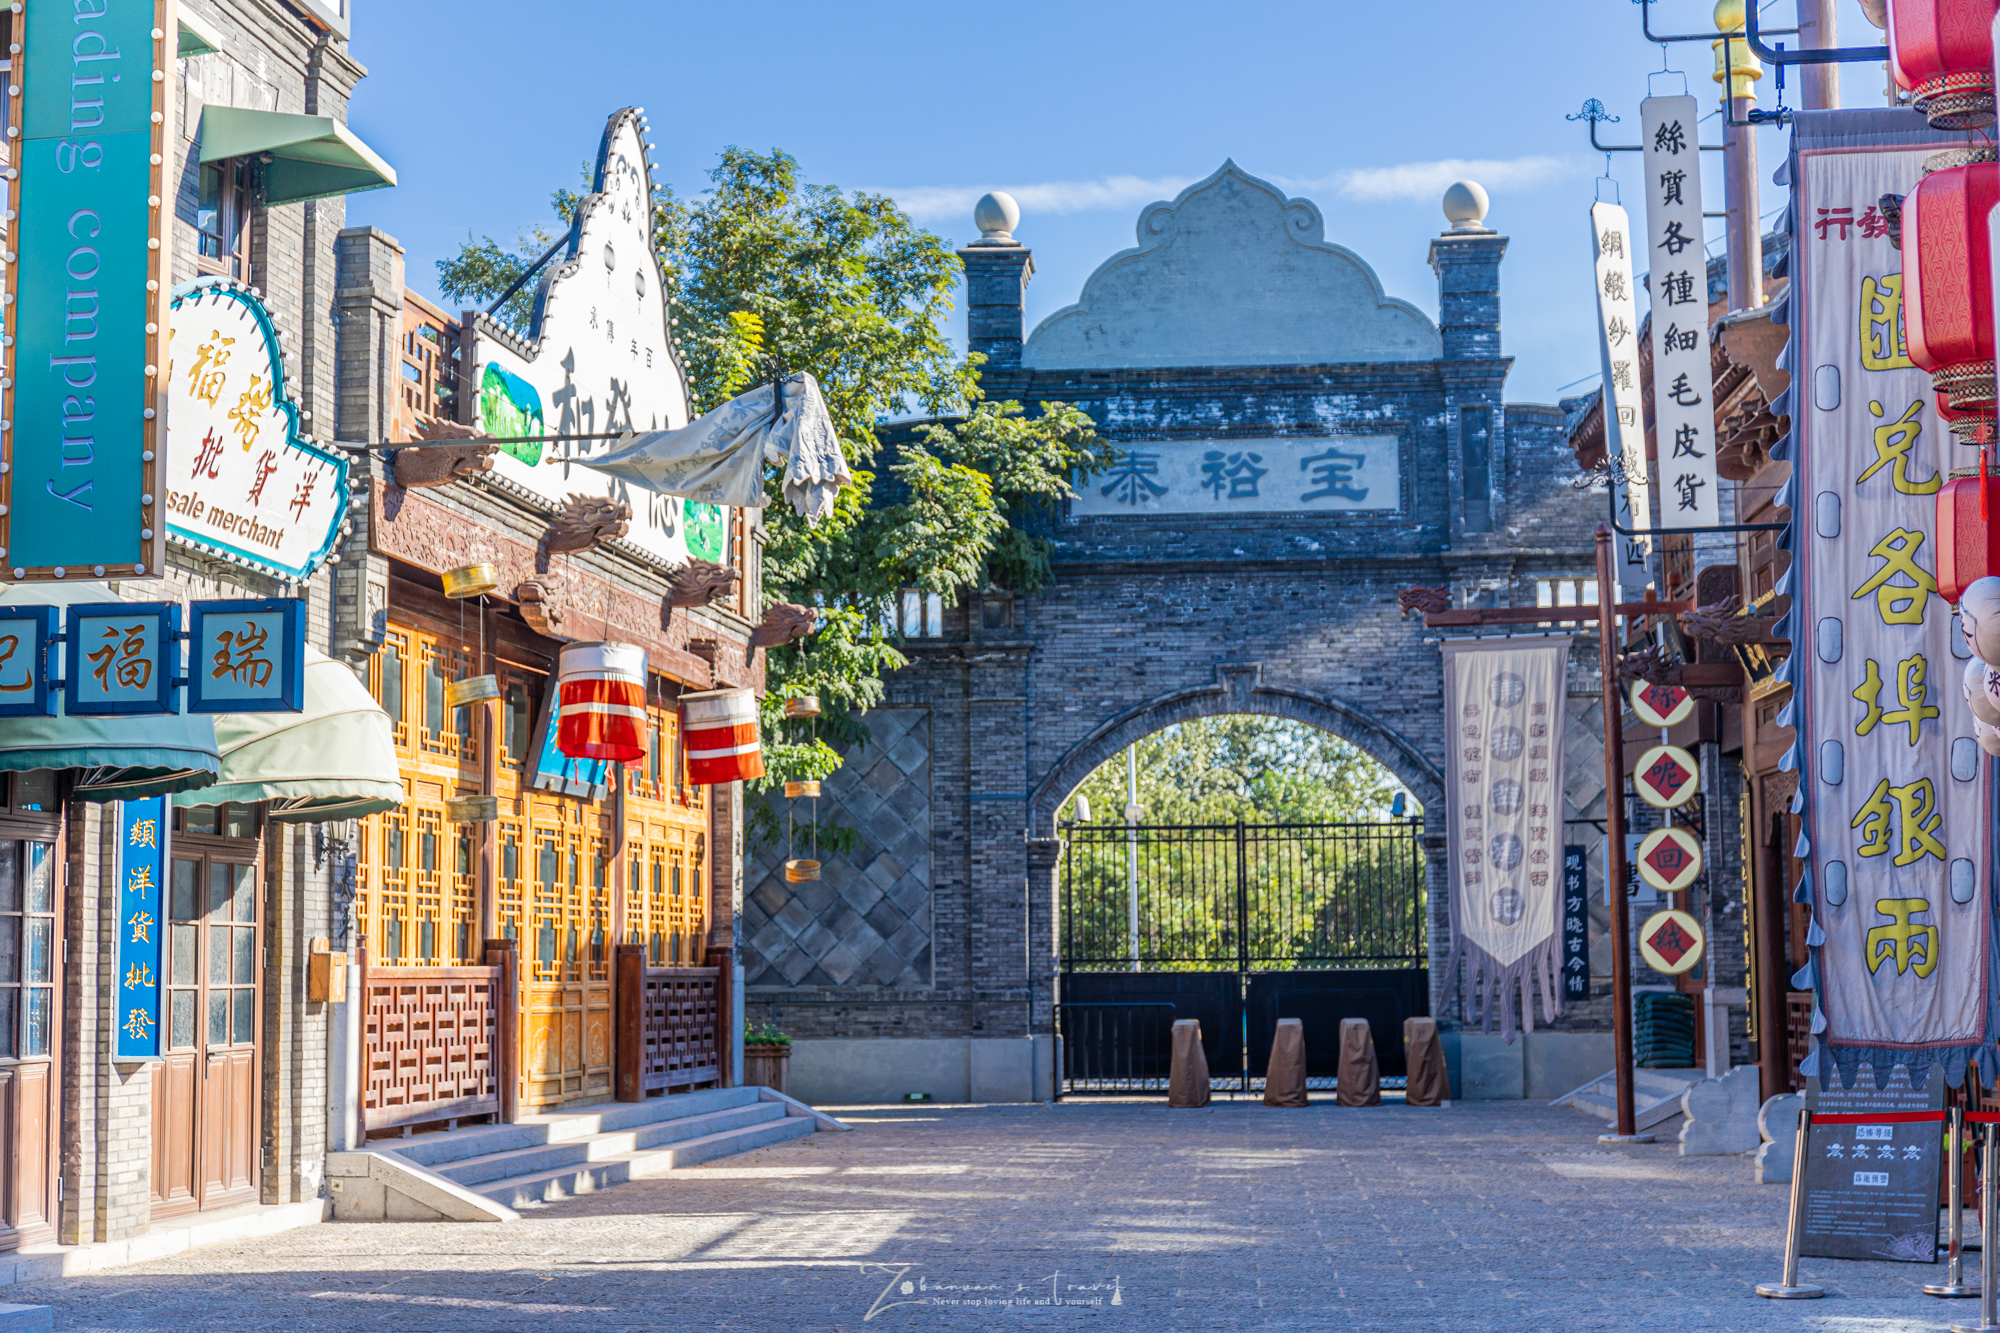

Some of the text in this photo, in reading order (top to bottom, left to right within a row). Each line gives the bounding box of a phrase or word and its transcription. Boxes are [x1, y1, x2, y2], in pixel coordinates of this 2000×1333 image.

[46, 208, 101, 513] company
[1653, 119, 1706, 512] 絲質各種細毛皮貨
[206, 503, 284, 550] merchant
[122, 797, 157, 1040] 類洋貨批發
[1565, 854, 1586, 992] 观书方晓古今情
